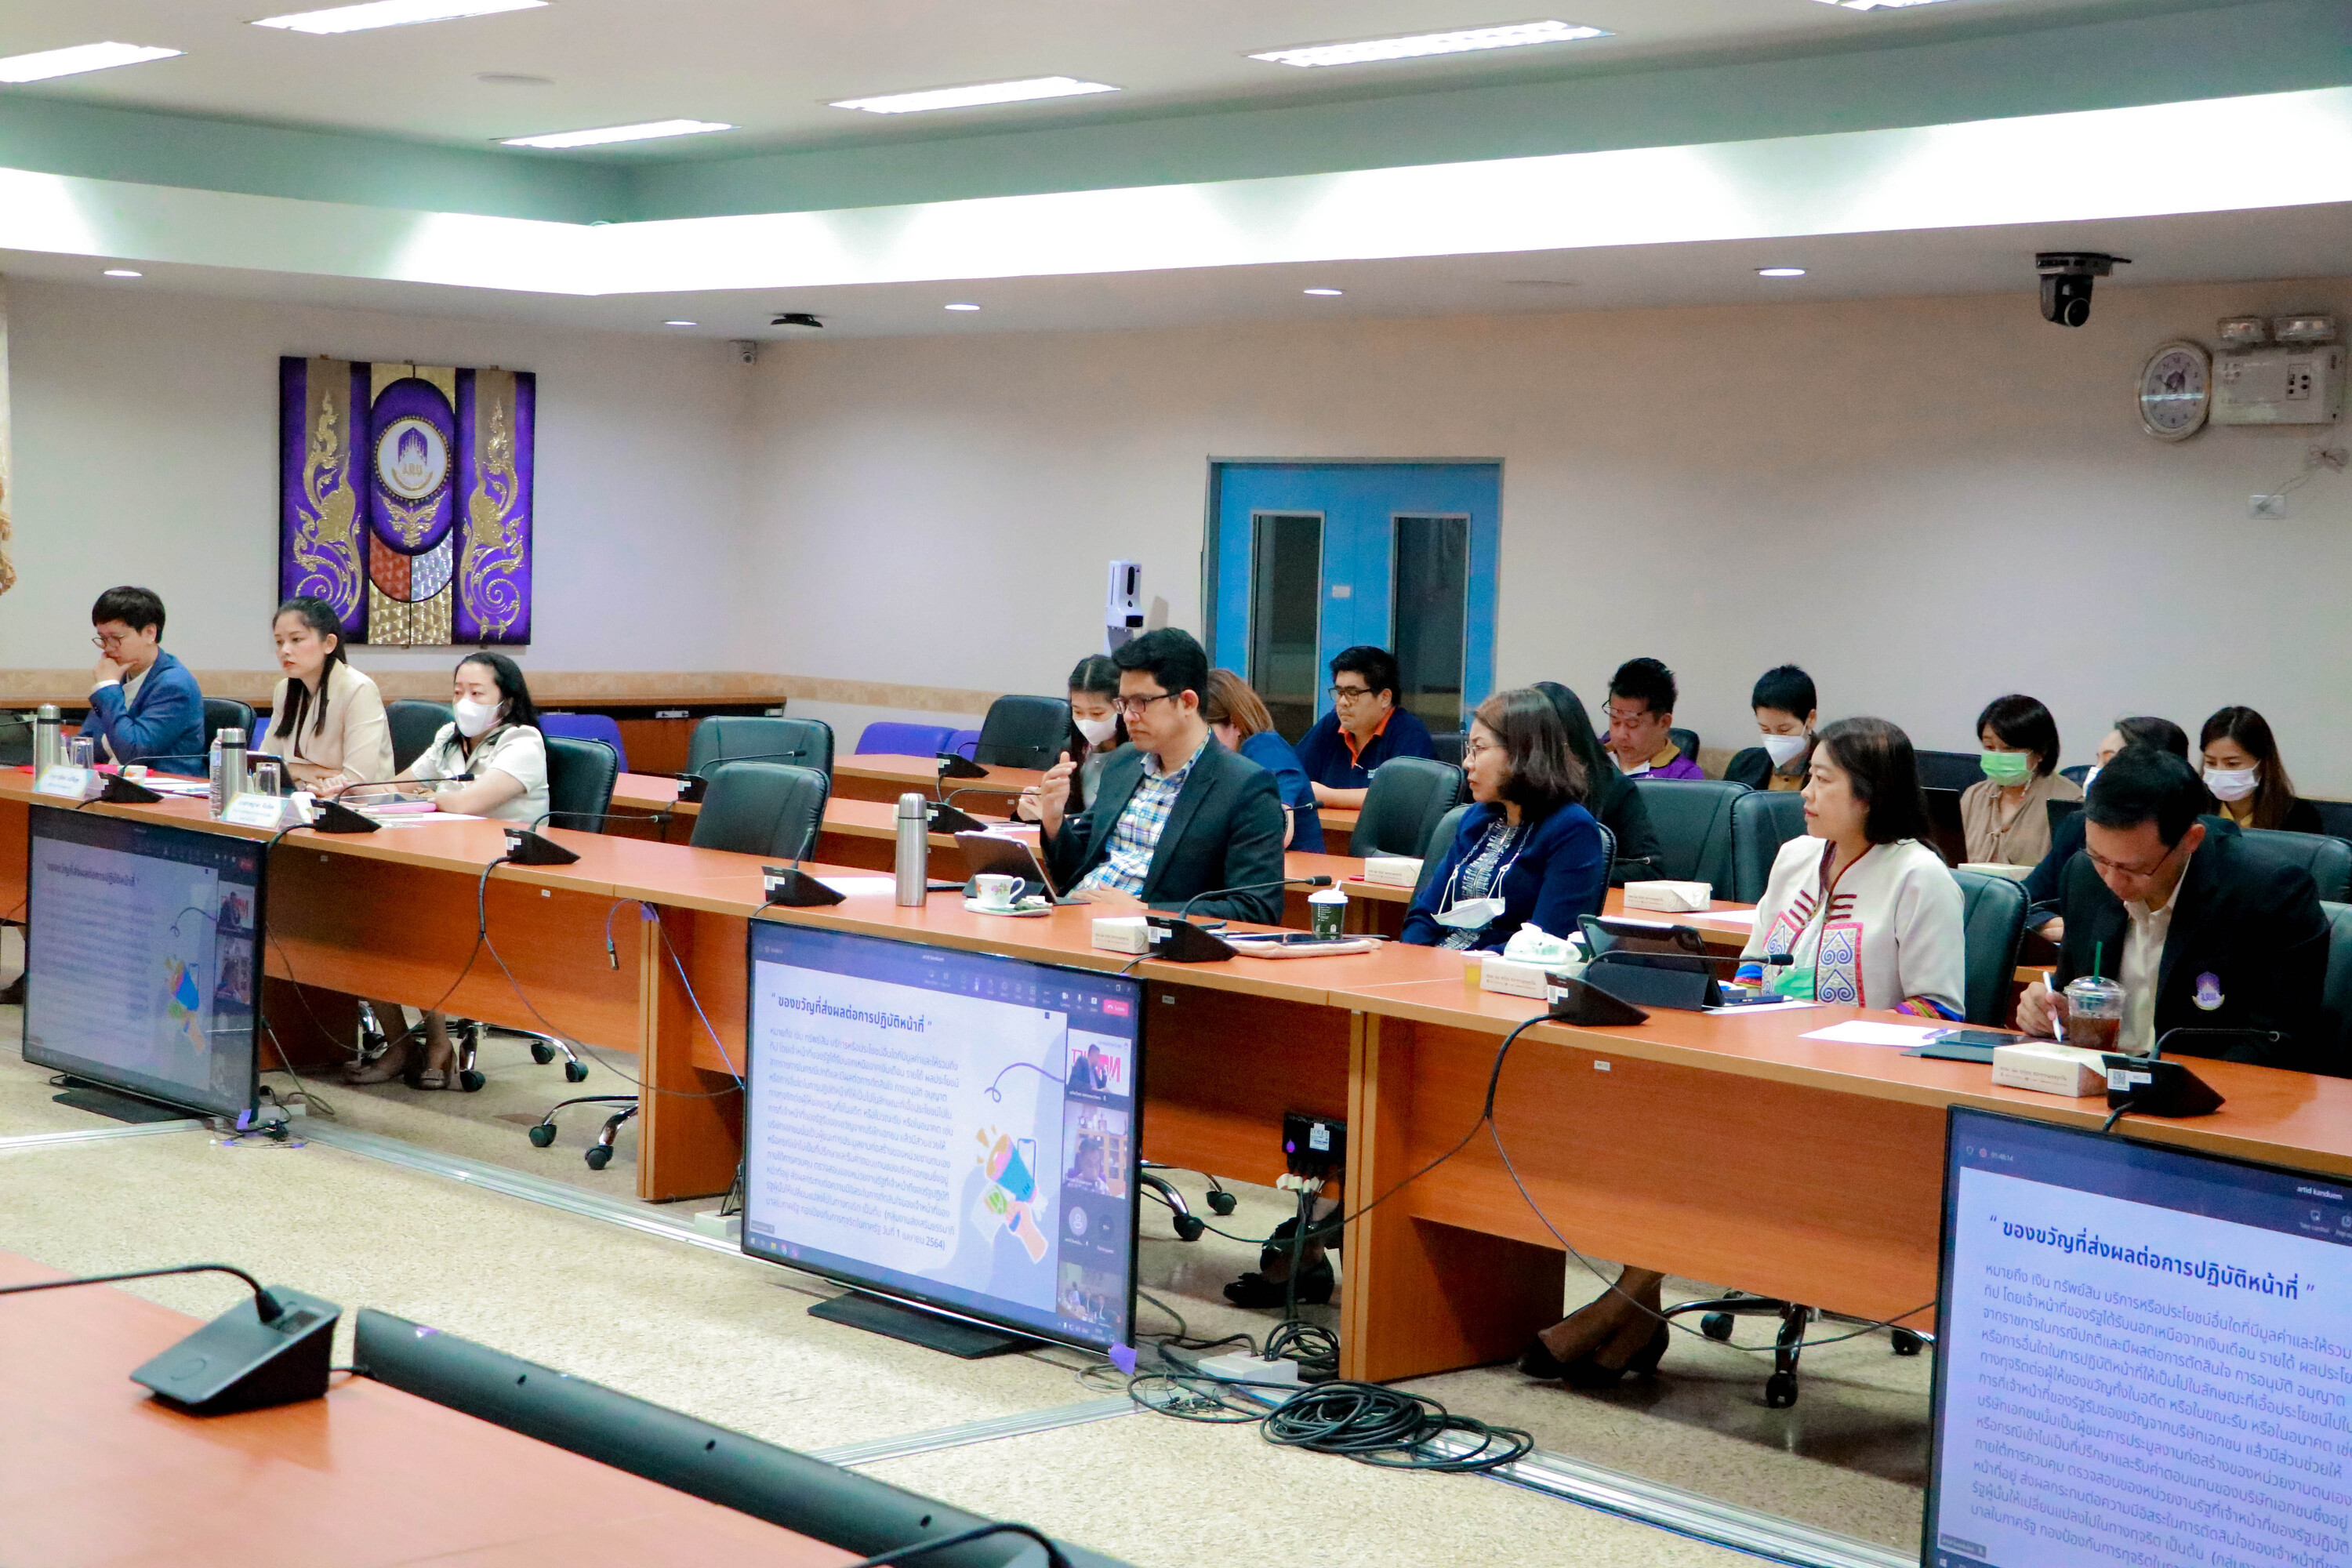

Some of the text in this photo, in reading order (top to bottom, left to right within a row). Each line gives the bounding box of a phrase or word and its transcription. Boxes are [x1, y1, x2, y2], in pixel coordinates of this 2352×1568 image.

[779, 993, 924, 1034] ของขวัญที่ส่งผลต่อการปฏิบัติหน้าที่
[2002, 1221, 2299, 1301] ของขวัญที่ส่งผลต่อการปฏิบัติหน้าที่
